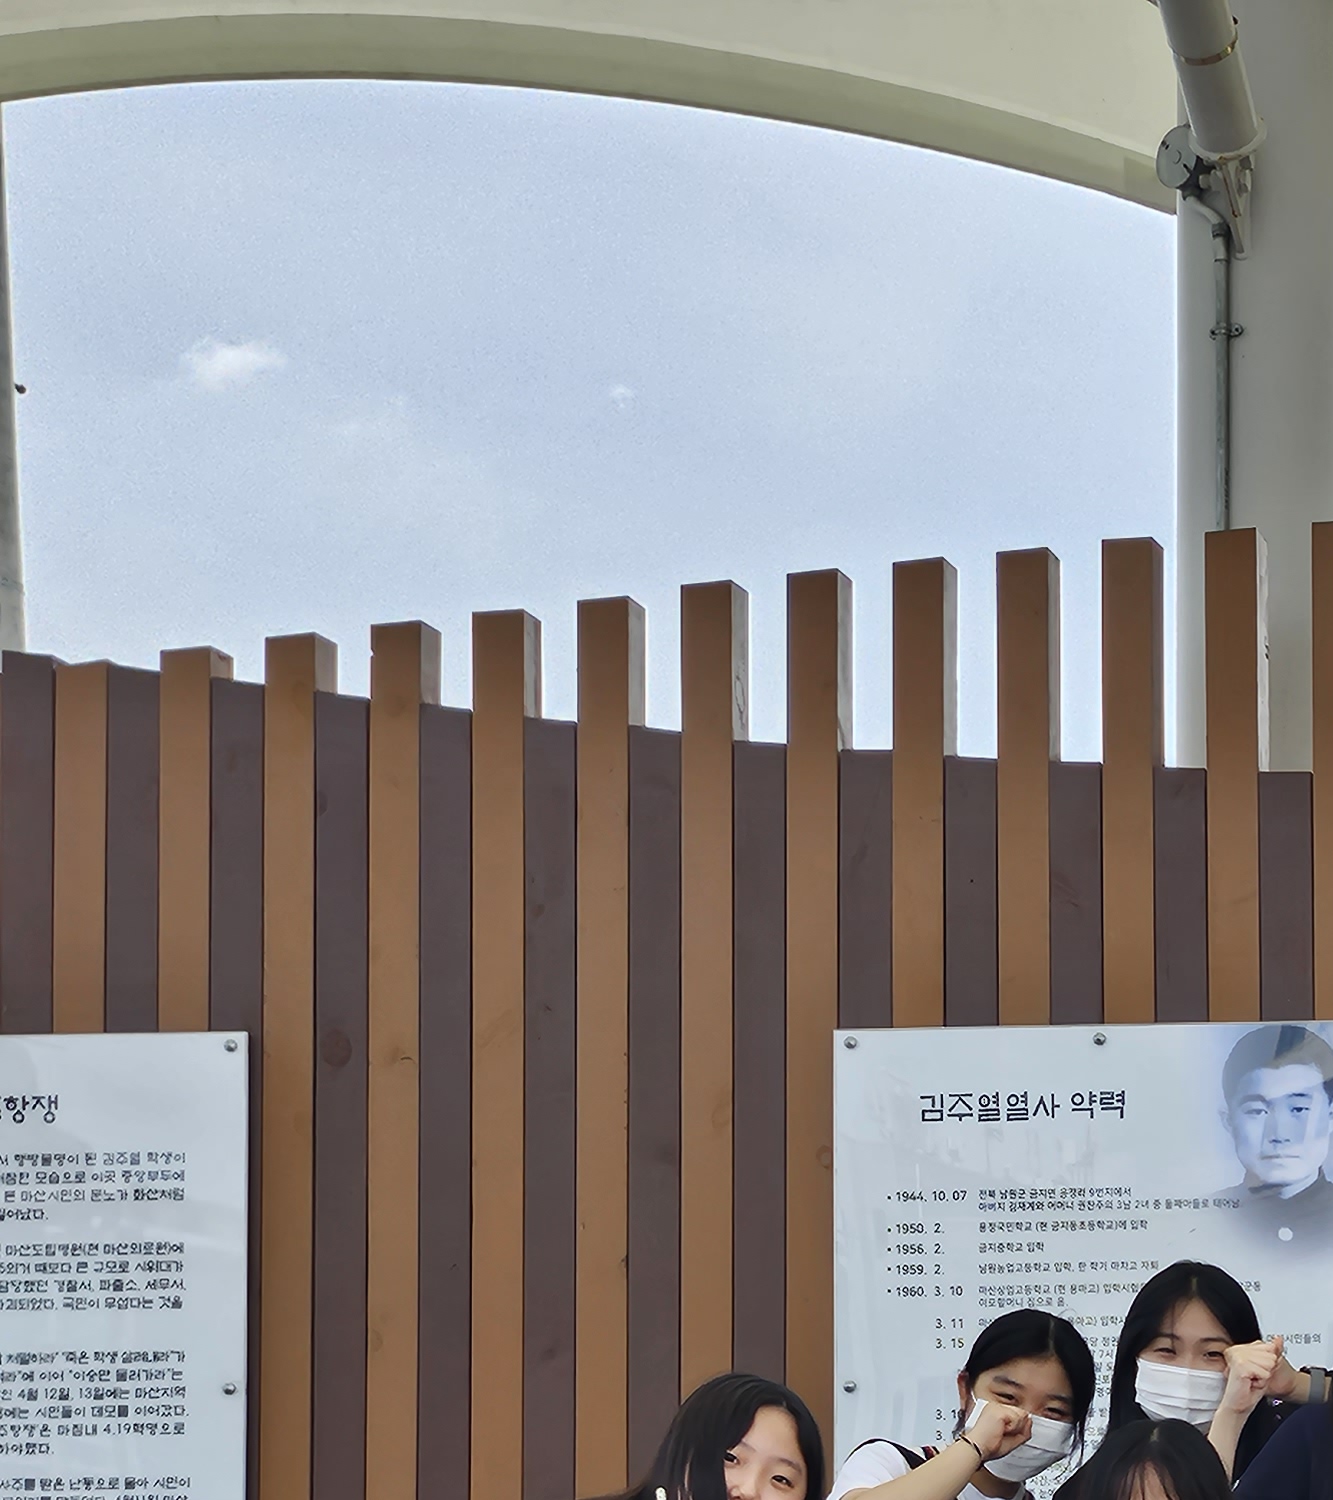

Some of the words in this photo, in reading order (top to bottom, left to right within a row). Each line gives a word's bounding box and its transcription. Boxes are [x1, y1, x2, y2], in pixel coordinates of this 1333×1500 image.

[919, 1092, 1060, 1123] 김주열열사
[1070, 1090, 1127, 1121] 약력
[147, 1152, 185, 1164] 학생이
[36, 1171, 85, 1184] 모습으로
[91, 1171, 115, 1183] 이곳
[21, 1189, 85, 1202] 마산시민의
[134, 1188, 184, 1201] 화산처럼
[953, 1190, 967, 1200] 07
[934, 1223, 944, 1233] 2.
[934, 1243, 944, 1254] 2.
[35, 1263, 72, 1274] 때보다
[76, 1262, 88, 1273] 큰
[94, 1261, 129, 1273] 규모로
[135, 1260, 183, 1272] 시위대가
[934, 1264, 944, 1274] 2.
[935, 1286, 944, 1296] 3.
[950, 1286, 963, 1296] 10
[63, 1297, 99, 1310] 국민이
[105, 1297, 153, 1309] 무섭다는
[159, 1296, 182, 1309] 것을
[936, 1319, 945, 1329] 3.
[951, 1319, 963, 1328] 11
[936, 1338, 946, 1349] 3.
[951, 1338, 964, 1348] 15
[94, 1352, 118, 1363] 학생
[39, 1371, 64, 1381] 이어
[18, 1388, 38, 1401] 4월
[80, 1387, 130, 1400] 13일에는
[135, 1386, 185, 1399] 마산지역
[35, 1406, 85, 1419] 시민들이
[91, 1405, 128, 1417] 데모를
[58, 1424, 97, 1436] 마침내
[103, 1423, 184, 1435] 4.19혁명으로
[70, 1477, 119, 1490] 난동으로
[125, 1477, 149, 1490] 몰아
[153, 1477, 190, 1489] 시민이
